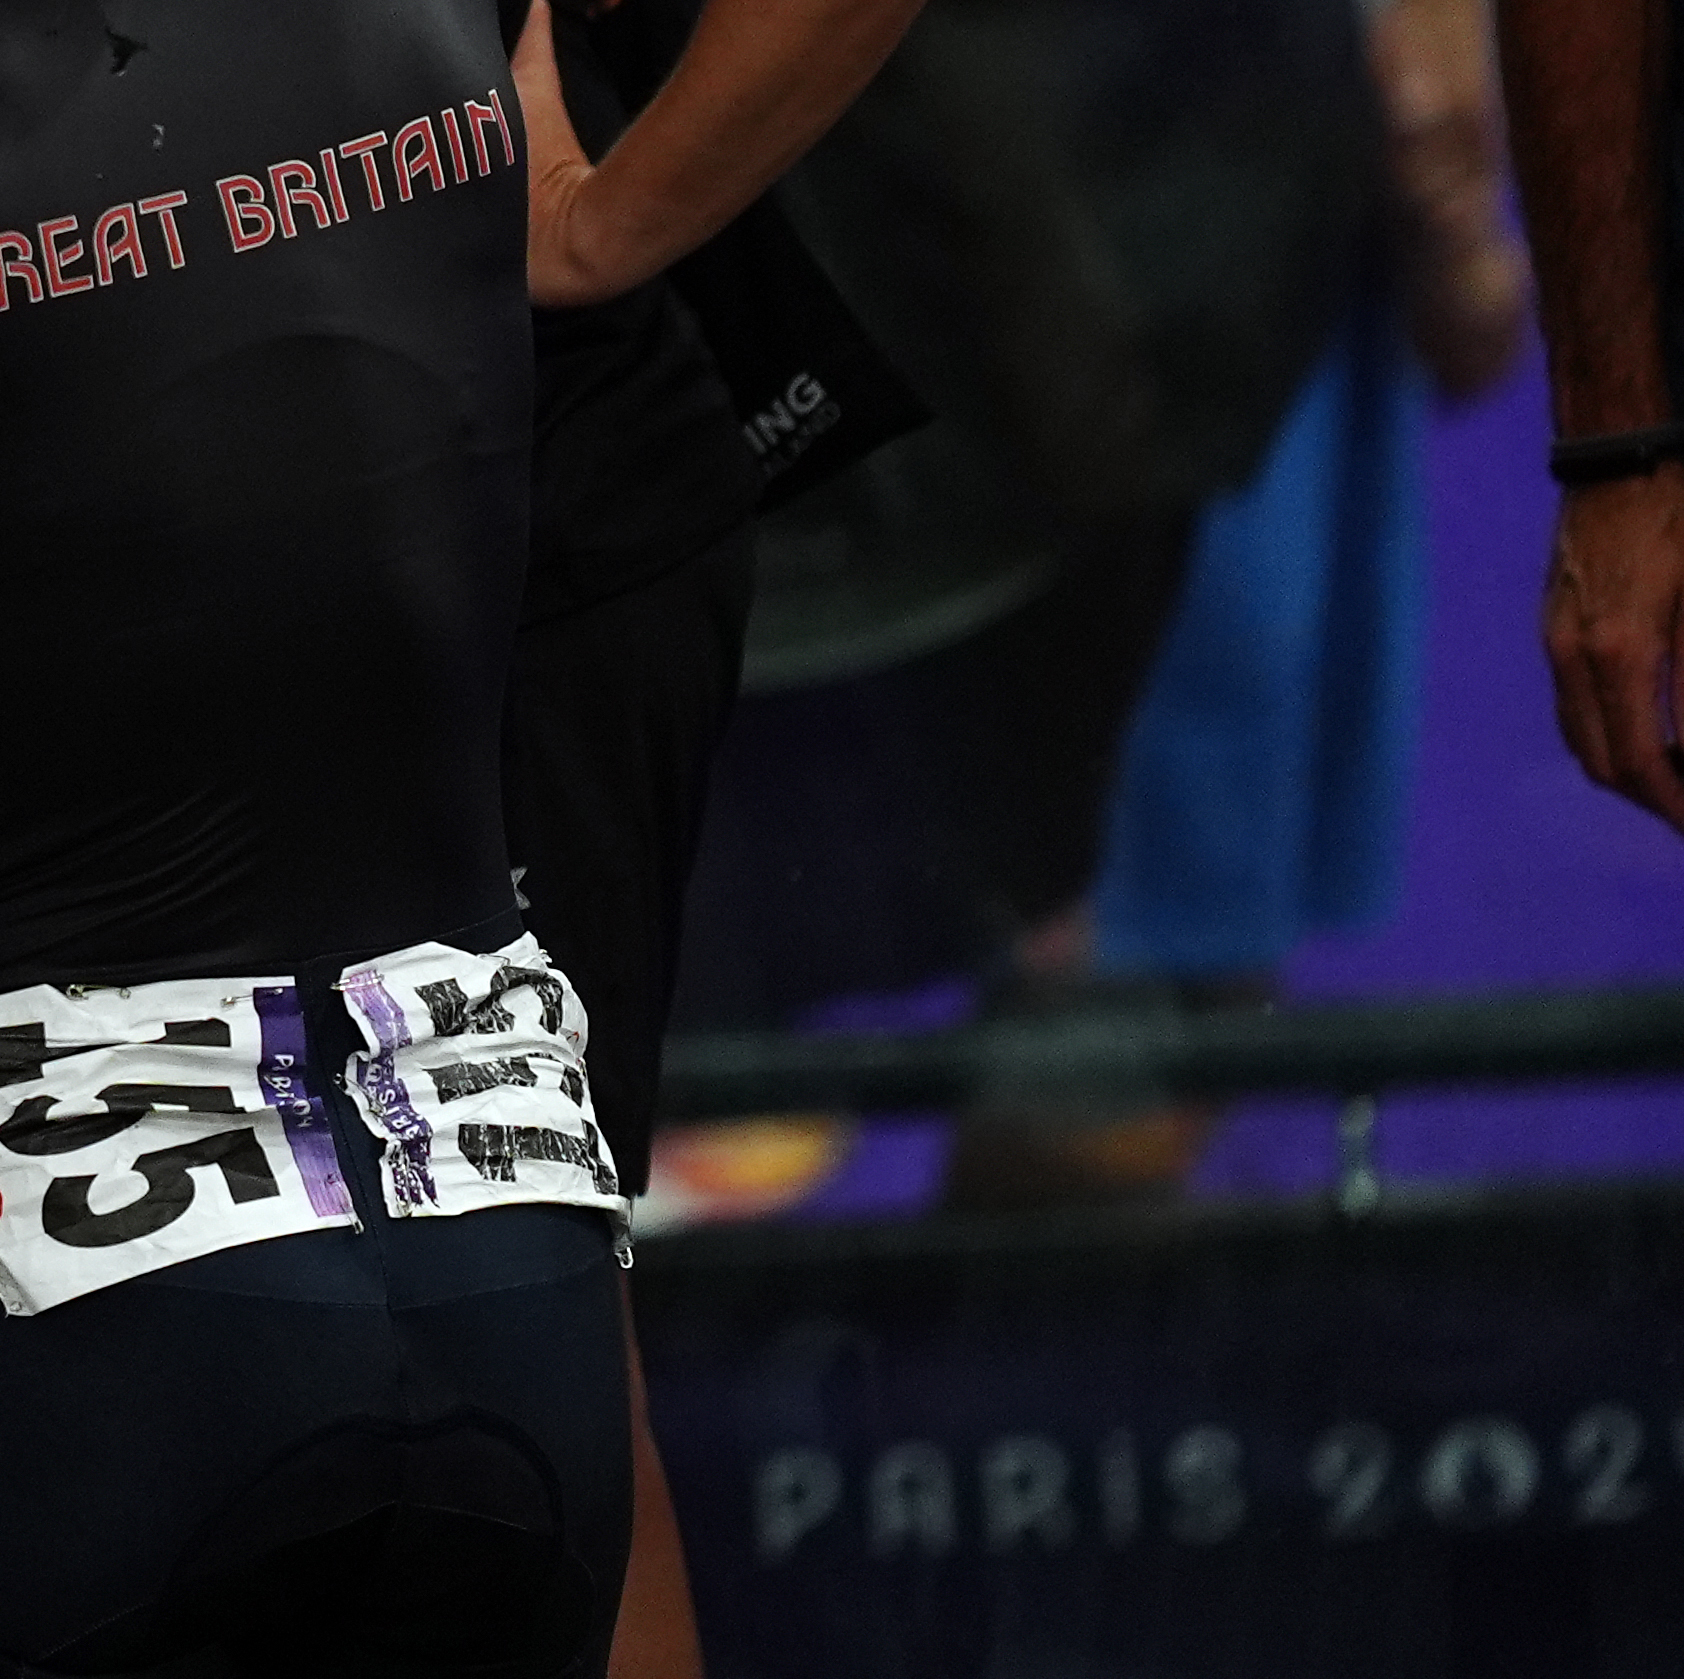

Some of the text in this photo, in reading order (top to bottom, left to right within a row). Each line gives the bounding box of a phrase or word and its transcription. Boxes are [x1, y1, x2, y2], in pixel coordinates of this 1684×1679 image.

[215, 88, 516, 254] BRITAIN
[754, 1403, 1684, 1566] PARIS 202
